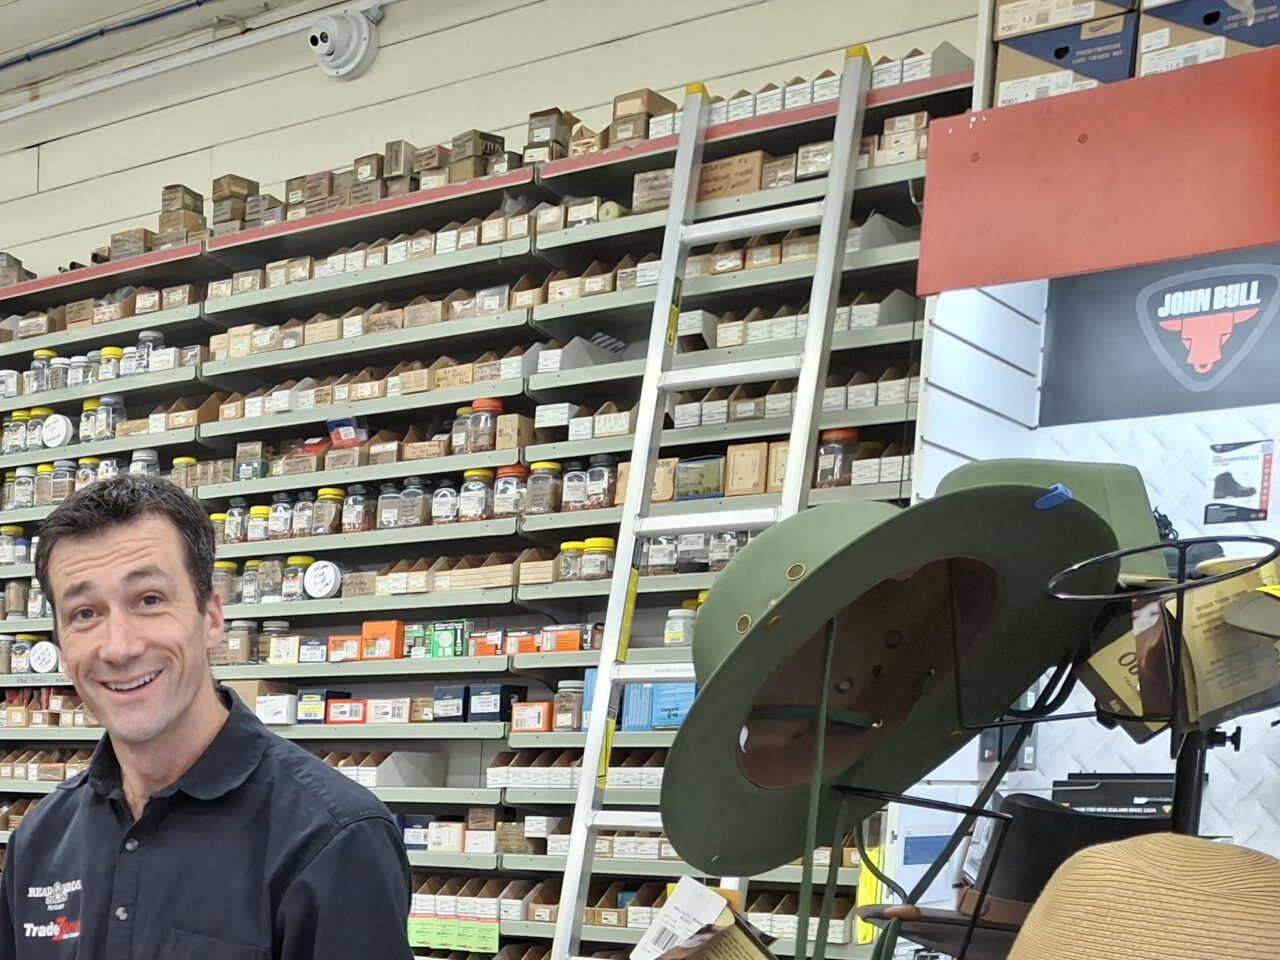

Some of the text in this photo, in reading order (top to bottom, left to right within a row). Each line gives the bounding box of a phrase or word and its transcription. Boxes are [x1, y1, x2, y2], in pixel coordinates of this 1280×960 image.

[1157, 280, 1262, 318] JOHN BULL
[27, 886, 54, 898] READ
